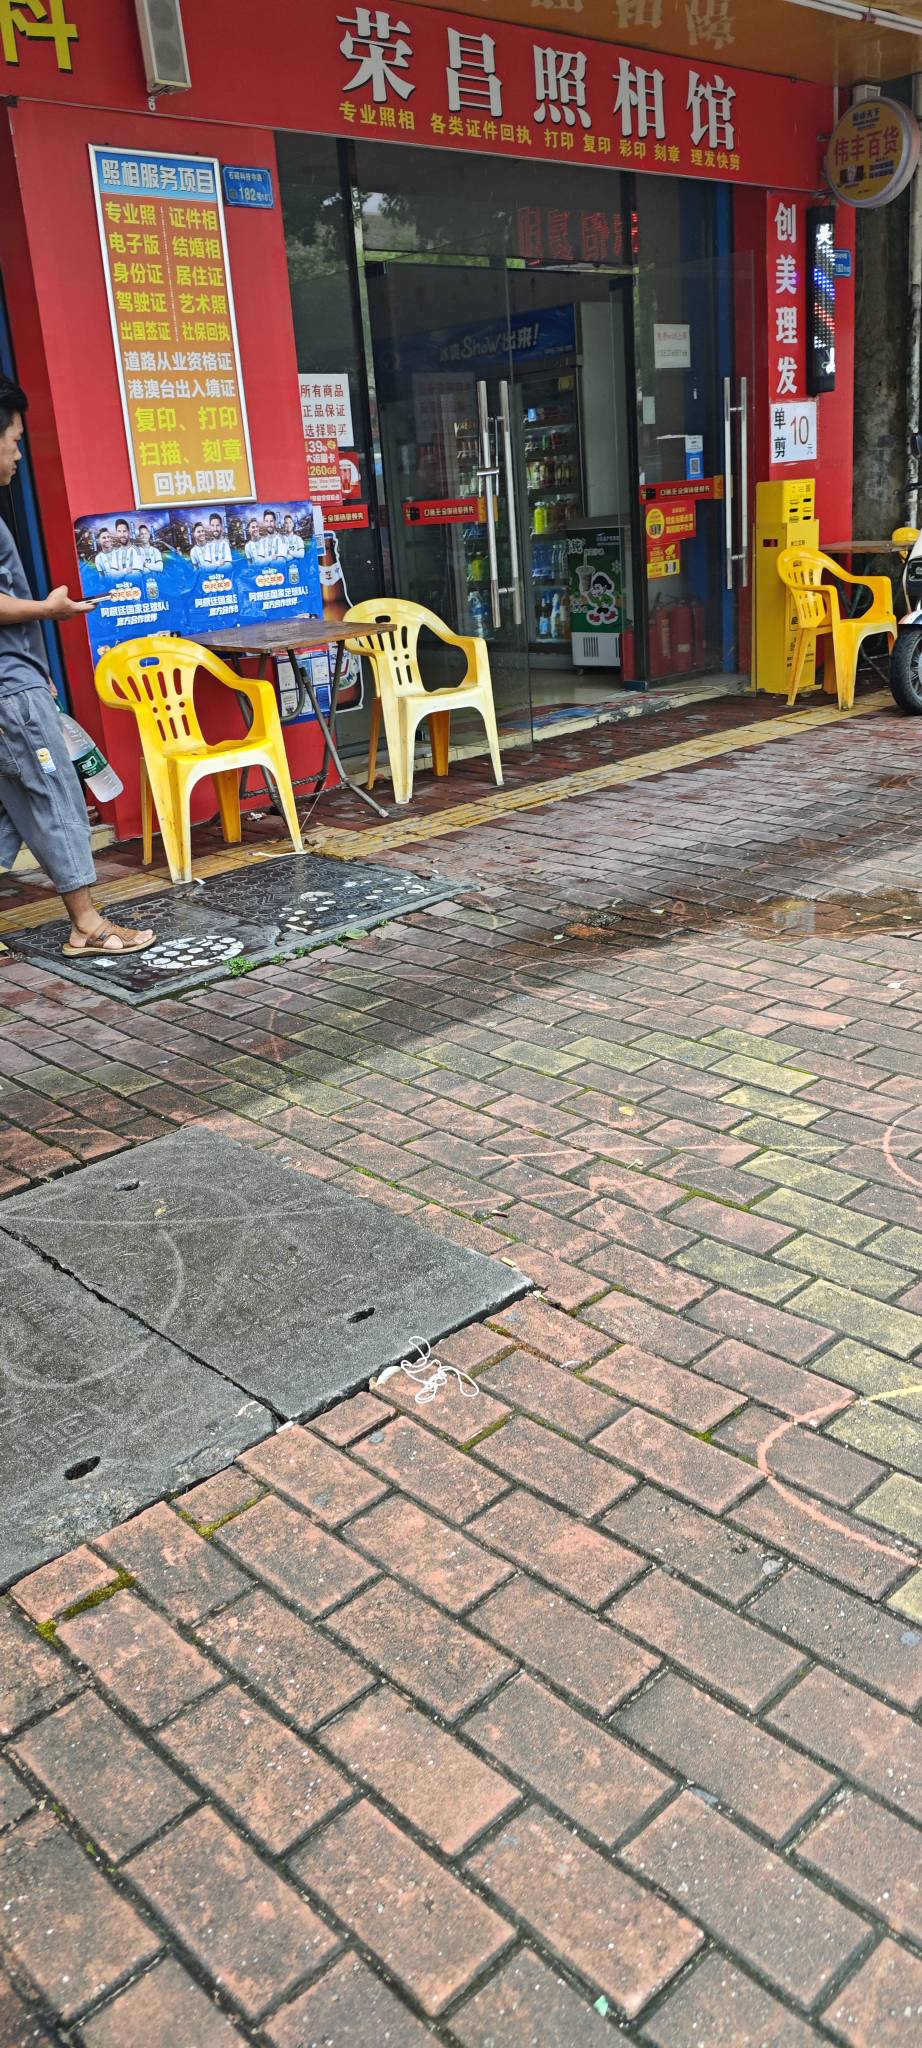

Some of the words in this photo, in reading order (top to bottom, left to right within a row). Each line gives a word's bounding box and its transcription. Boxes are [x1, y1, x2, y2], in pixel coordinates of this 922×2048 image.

[336, 7, 736, 150] 荣昌照相馆
[339, 101, 415, 130] 专业照相
[430, 113, 532, 145] 各类证件回执
[544, 128, 574, 150] 打印
[583, 134, 611, 155] 复印
[619, 139, 646, 160] 彩印
[654, 143, 680, 163] 刻章
[691, 148, 741, 171] 理发快剪
[834, 125, 899, 167] 伟丰百货
[102, 159, 216, 194] 照相服务项目
[105, 201, 157, 226] 专业照
[169, 206, 218, 231] 证件相
[109, 232, 160, 255] 电子版
[172, 236, 221, 259] 结婚相
[113, 262, 164, 284] 身份证
[176, 265, 224, 287] 居住证
[116, 290, 168, 313] 驾驶证
[178, 293, 227, 315] 艺术照
[774, 202, 798, 394] 创美理发
[120, 320, 171, 341] 出国签证
[182, 322, 230, 342] 社保回执
[124, 351, 233, 372] 道路从业资格证
[128, 379, 236, 399] 港澳台出入境证
[301, 384, 344, 398] 所有商品
[303, 404, 346, 418] 正品保证
[305, 424, 347, 438] 选择购买
[774, 407, 786, 458] 单剪
[153, 469, 236, 496] 回执即取
